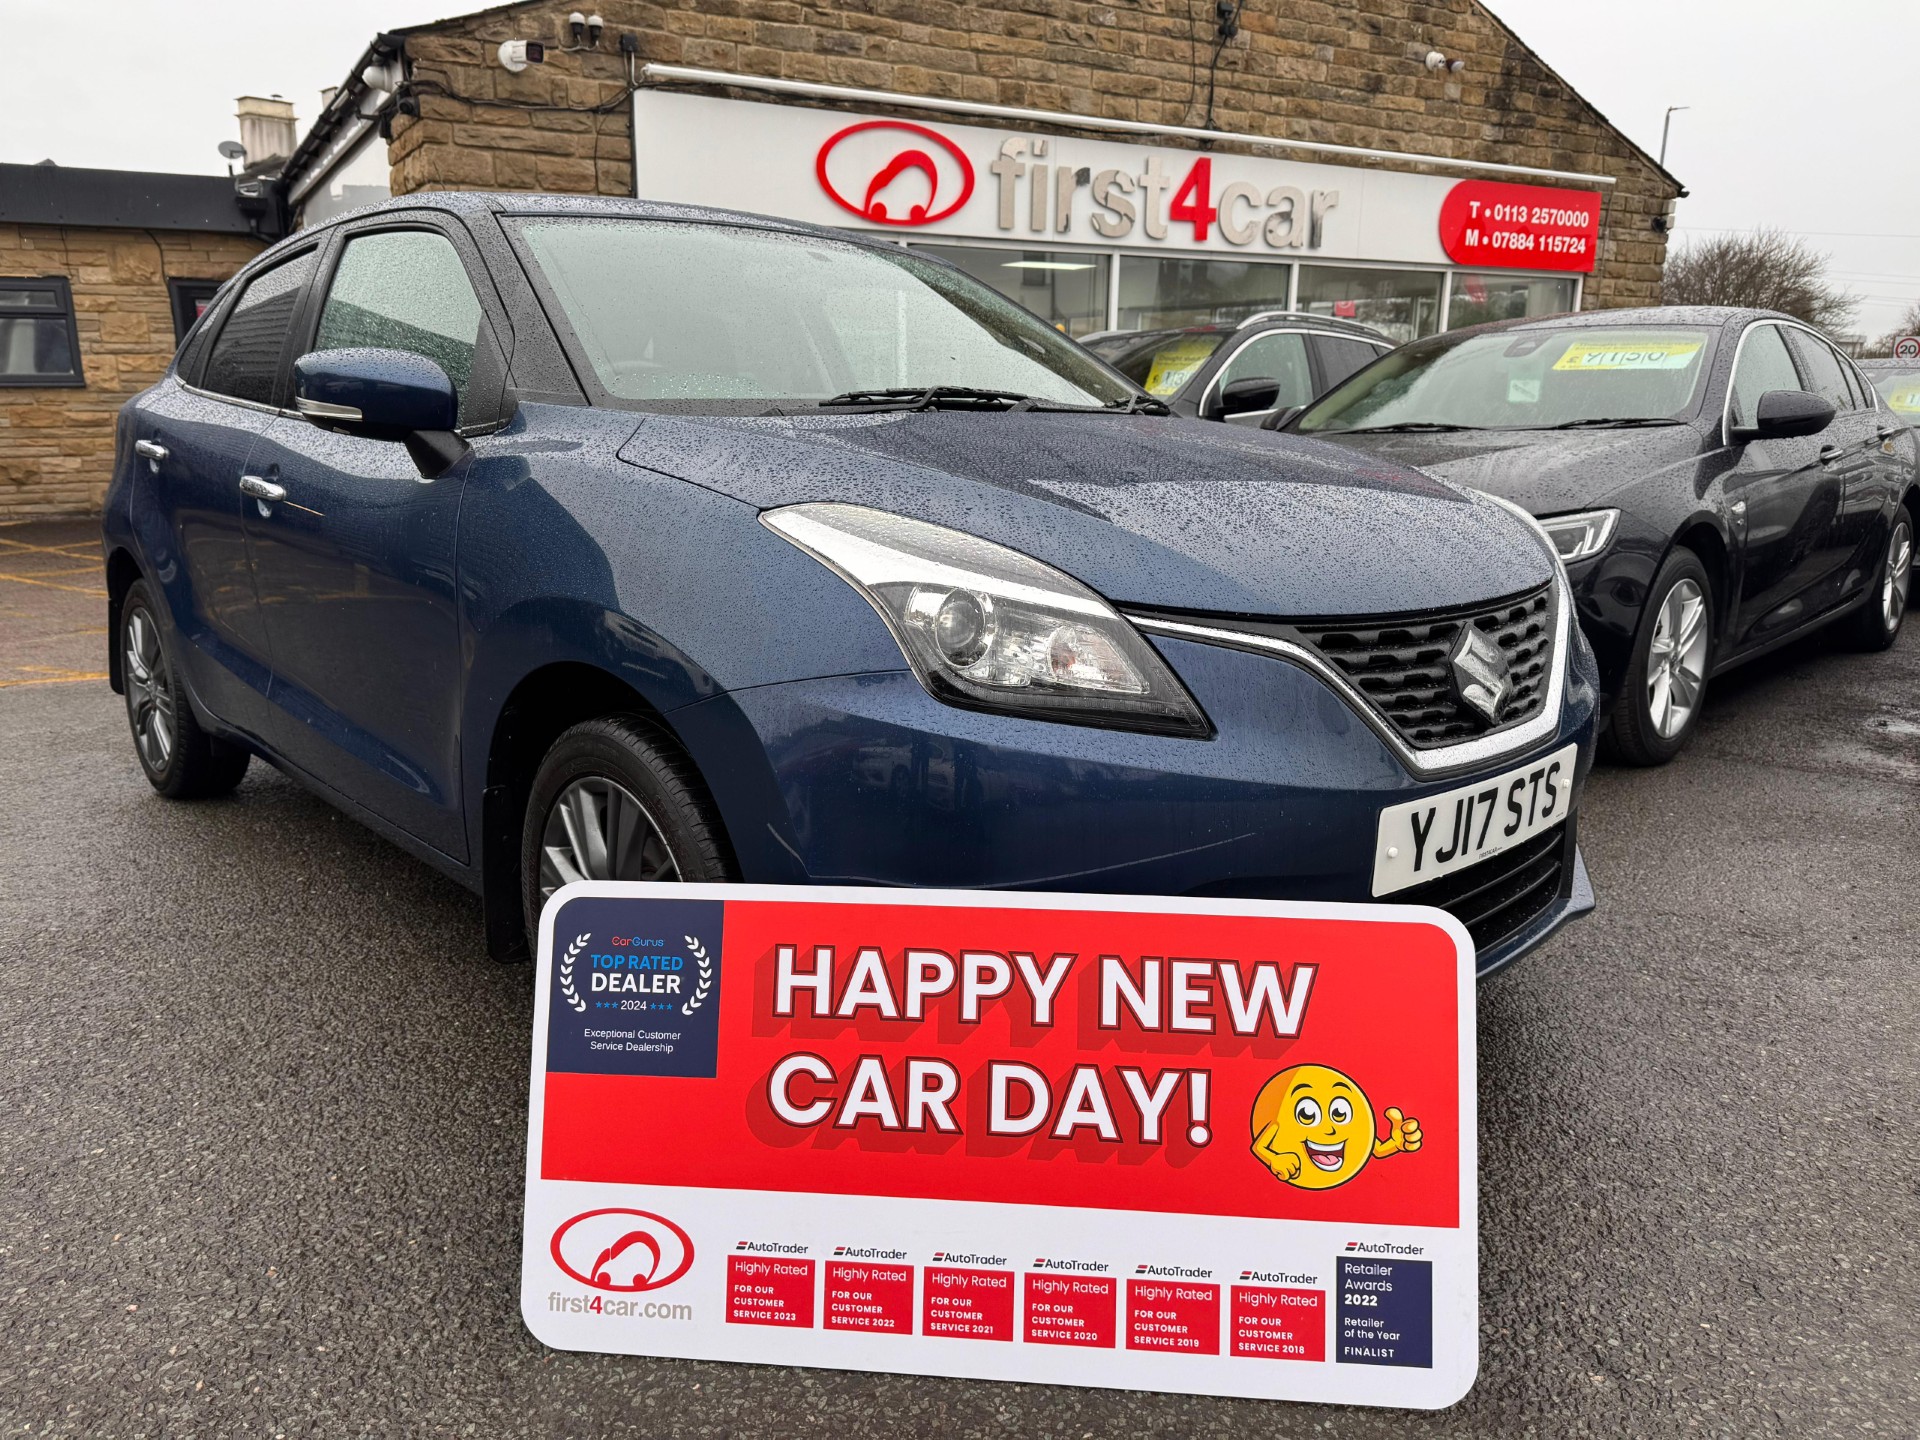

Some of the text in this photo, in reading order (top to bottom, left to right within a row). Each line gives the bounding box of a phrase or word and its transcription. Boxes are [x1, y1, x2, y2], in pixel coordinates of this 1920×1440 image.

[991, 137, 1339, 249] first4car
[1469, 201, 1589, 228] T 0113 2570000
[1465, 229, 1586, 254] M 07884 115724
[1900, 344, 1917, 355] 20
[1411, 761, 1560, 872] YJ17 STS
[612, 936, 664, 947] CarGurus
[591, 954, 683, 971] TOP RATED
[591, 973, 681, 994] DEALER
[773, 944, 1319, 1039] HAPPY NEW
[620, 1000, 647, 1011] 2024
[584, 1029, 681, 1040] Exceptional Customer
[590, 1041, 674, 1054] Service Dealership
[767, 1052, 1212, 1148] CAR DAY!
[747, 1241, 808, 1254] AutoTrader
[845, 1247, 907, 1260] AutoTrader
[1357, 1242, 1424, 1255] AutoTrader
[944, 1253, 1007, 1266] AutoTrader
[1045, 1258, 1109, 1272] AutoTrader
[735, 1261, 807, 1276] Highly Rated
[832, 1267, 907, 1282] Highly Rated
[1147, 1265, 1212, 1278] AutoTrader
[1345, 1263, 1392, 1276] Retailer
[932, 1273, 1007, 1288] Highly Rated
[1251, 1271, 1317, 1285] AutoTrader
[734, 1284, 774, 1294] FOR OUR
[1032, 1279, 1109, 1295] Highly Rated
[1345, 1279, 1392, 1292] Awards
[832, 1291, 872, 1301] FOR OUR
[1135, 1285, 1212, 1301] Highly Rated
[548, 1291, 692, 1320] first4car.com
[734, 1297, 785, 1308] CUSTOMER
[931, 1297, 972, 1307] FOR OUR
[1239, 1292, 1317, 1308] Highly Rated
[1344, 1295, 1378, 1307] 2022
[832, 1303, 883, 1314] CUSTOMER
[1032, 1303, 1073, 1313] FOR OUR
[1134, 1309, 1177, 1320] FOR OUR
[733, 1310, 796, 1321] SERVICE 2023
[931, 1309, 983, 1321] CUSTOMER
[1032, 1315, 1085, 1327] CUSTOMER
[1239, 1316, 1281, 1326] FOR OUR
[831, 1316, 895, 1328] SERVICE 2022
[930, 1322, 993, 1334] SERVICE 2021
[1134, 1322, 1188, 1334] CUSTOMER
[1344, 1317, 1384, 1328] Retailer
[1031, 1329, 1098, 1341] SERVICE 2020
[1134, 1335, 1200, 1348] SERVICE 2019
[1239, 1329, 1293, 1341] CUSTOMER
[1344, 1329, 1400, 1341] of the Year
[1238, 1342, 1305, 1354] SERVICE 2018
[1344, 1347, 1395, 1358] FINALIST
